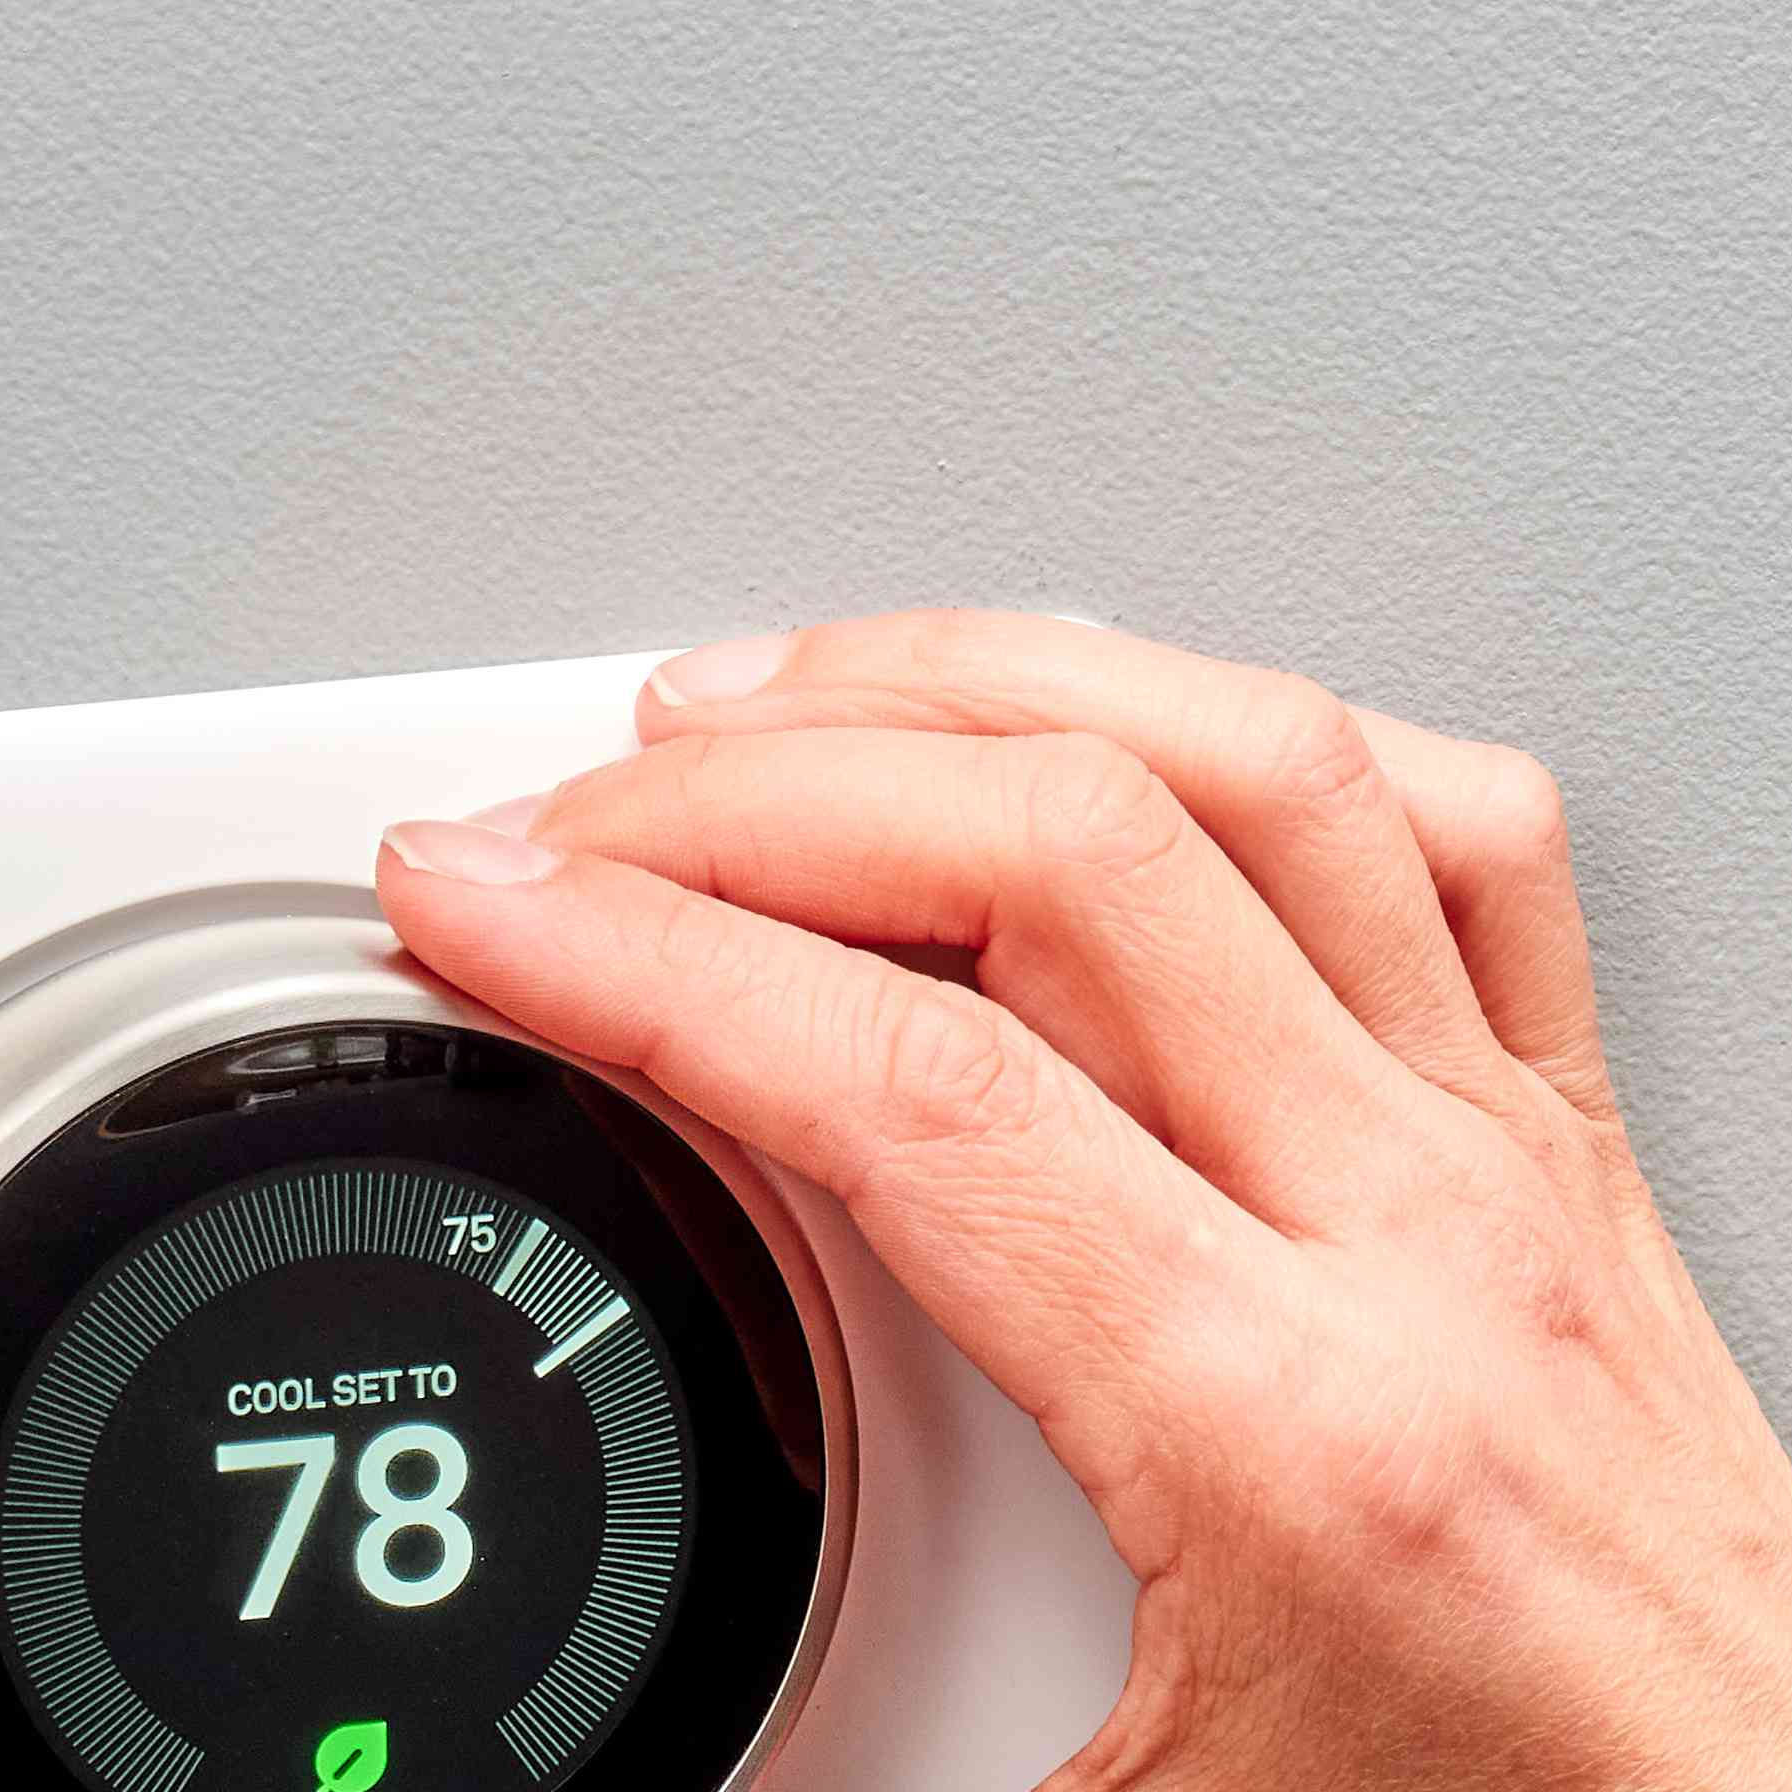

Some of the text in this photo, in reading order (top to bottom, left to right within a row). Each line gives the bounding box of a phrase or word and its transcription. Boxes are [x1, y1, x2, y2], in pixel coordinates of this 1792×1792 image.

[442, 1213, 497, 1256] 75
[227, 1364, 457, 1417] COOL SET TO
[215, 1422, 474, 1622] 78
